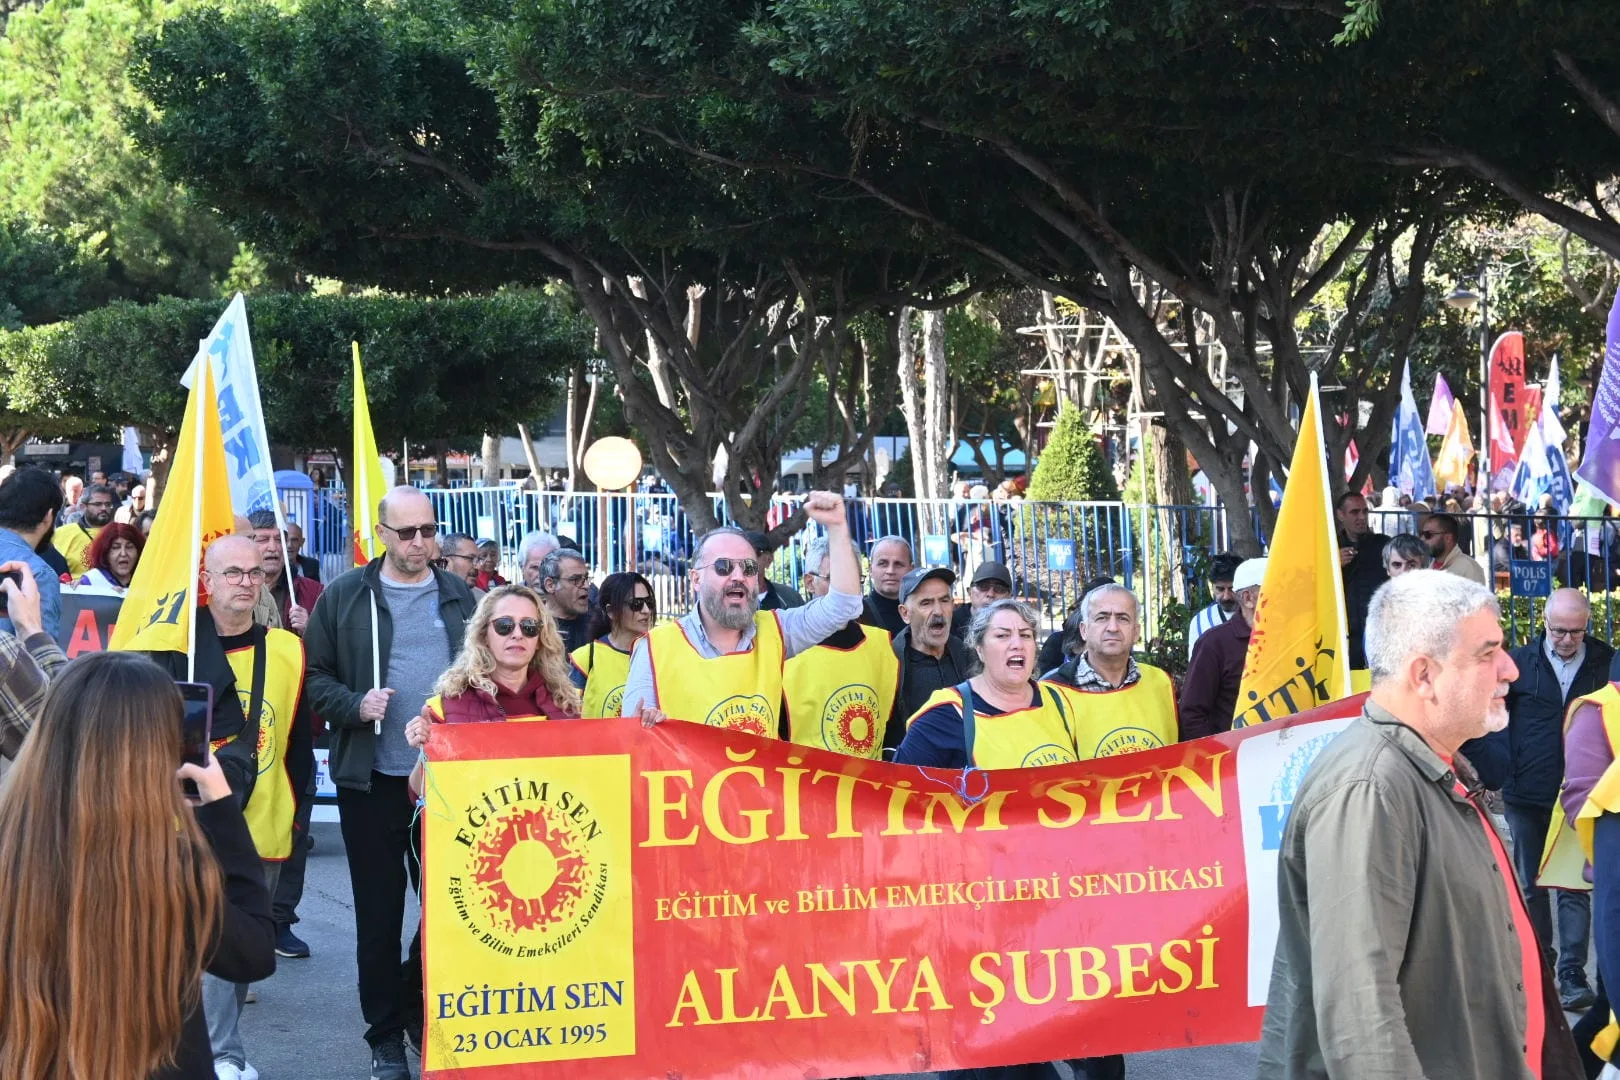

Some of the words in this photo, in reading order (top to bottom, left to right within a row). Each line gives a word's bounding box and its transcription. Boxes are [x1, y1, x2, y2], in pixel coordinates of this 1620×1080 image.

[1523, 580, 1538, 592] 07
[826, 691, 864, 722] EĞİTİM
[454, 777, 550, 848] EĞİTİM
[556, 791, 603, 842] SEN
[638, 746, 1018, 848] EĞİTİM
[1037, 750, 1232, 829] SEN
[448, 876, 469, 921] Eğitim
[468, 923, 481, 935] ve
[479, 932, 513, 956] Bilim
[516, 923, 582, 958] Emekçileri
[580, 862, 608, 928] Sendikası
[655, 889, 758, 921] EĞİTİM
[764, 898, 790, 915] ve
[796, 883, 878, 914] BİLİM
[886, 871, 1062, 911] EMEKÇİLERİ
[1068, 860, 1225, 899] SENDİKASİ
[436, 981, 556, 1019] EĞİTİM
[564, 980, 625, 1010] SEN
[665, 955, 954, 1028] ALANYA
[969, 924, 1221, 1025] ŞUBESİ
[453, 1033, 478, 1053] 23
[484, 1026, 553, 1050] OCAK
[559, 1023, 607, 1045] 1995
